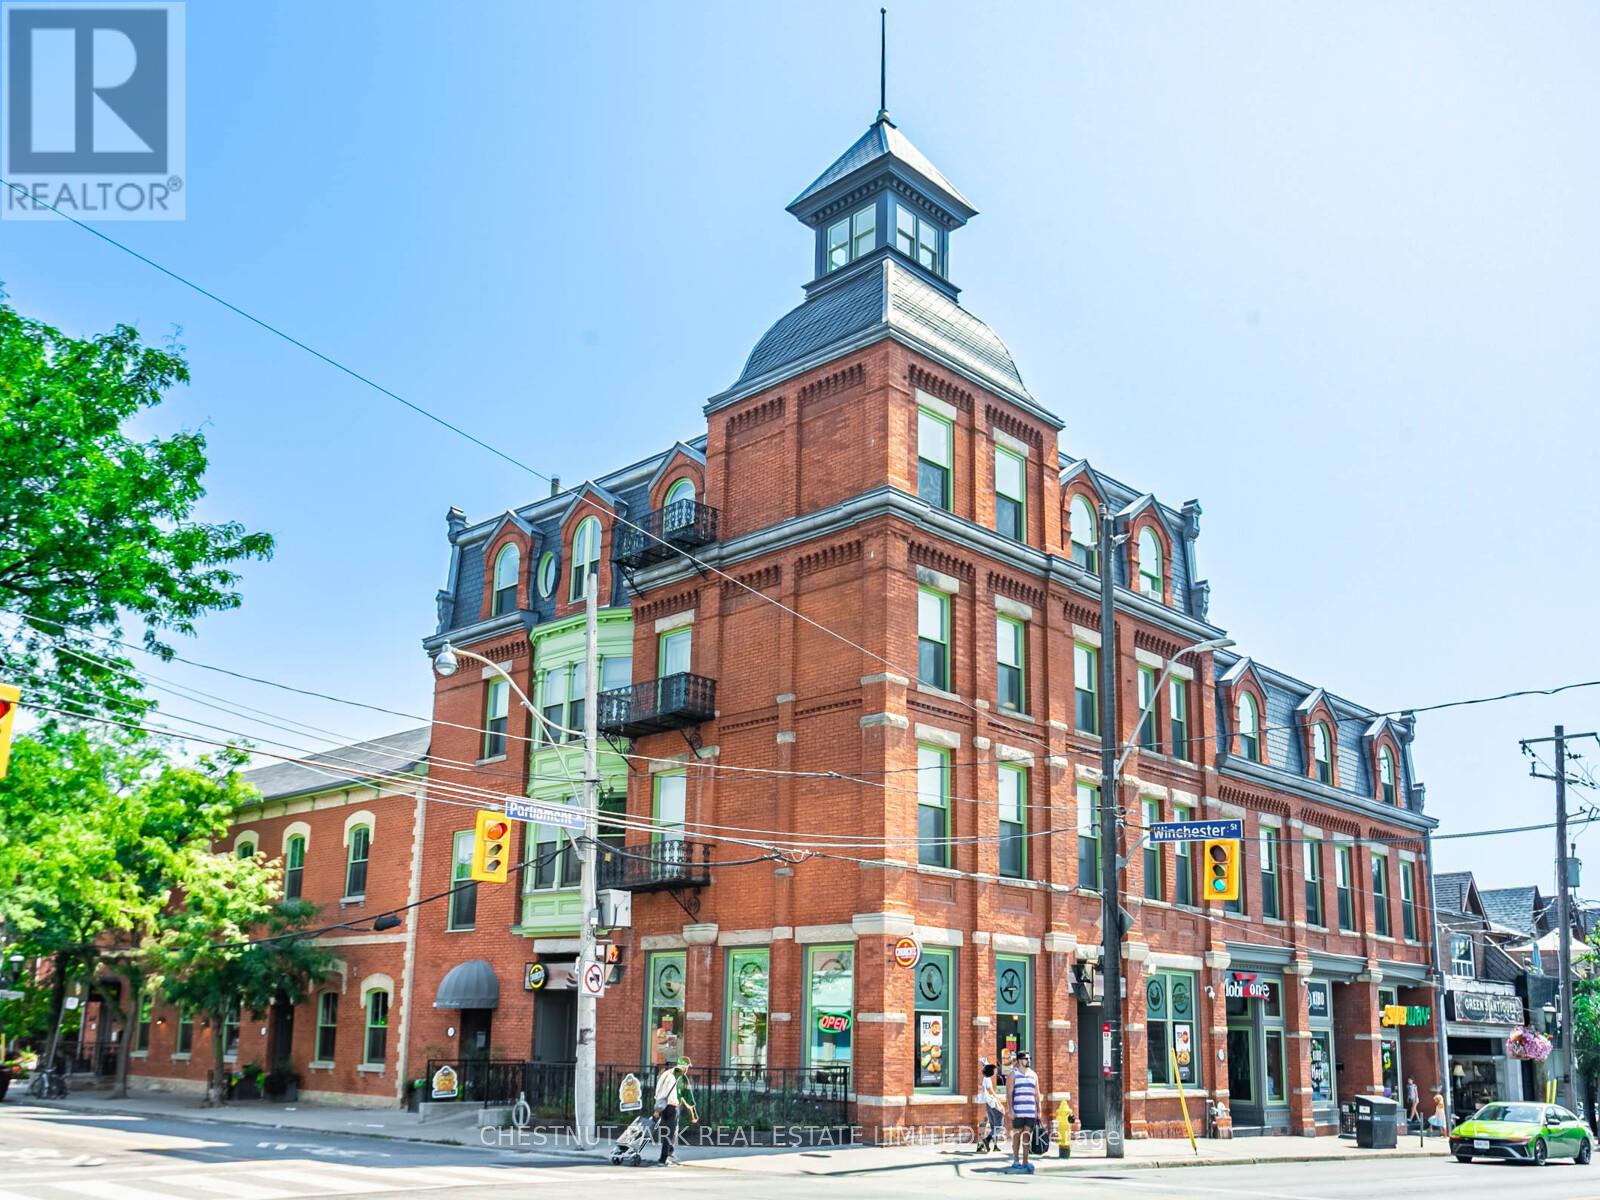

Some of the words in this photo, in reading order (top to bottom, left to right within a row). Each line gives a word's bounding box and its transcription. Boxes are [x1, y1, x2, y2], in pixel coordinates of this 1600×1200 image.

[509, 802, 572, 825] Parliament
[1153, 824, 1226, 840] Winchester
[1230, 823, 1238, 831] St
[1464, 998, 1489, 1012] GREENS
[821, 1015, 848, 1031] OPEN
[1382, 1004, 1431, 1027] SUBWAY
